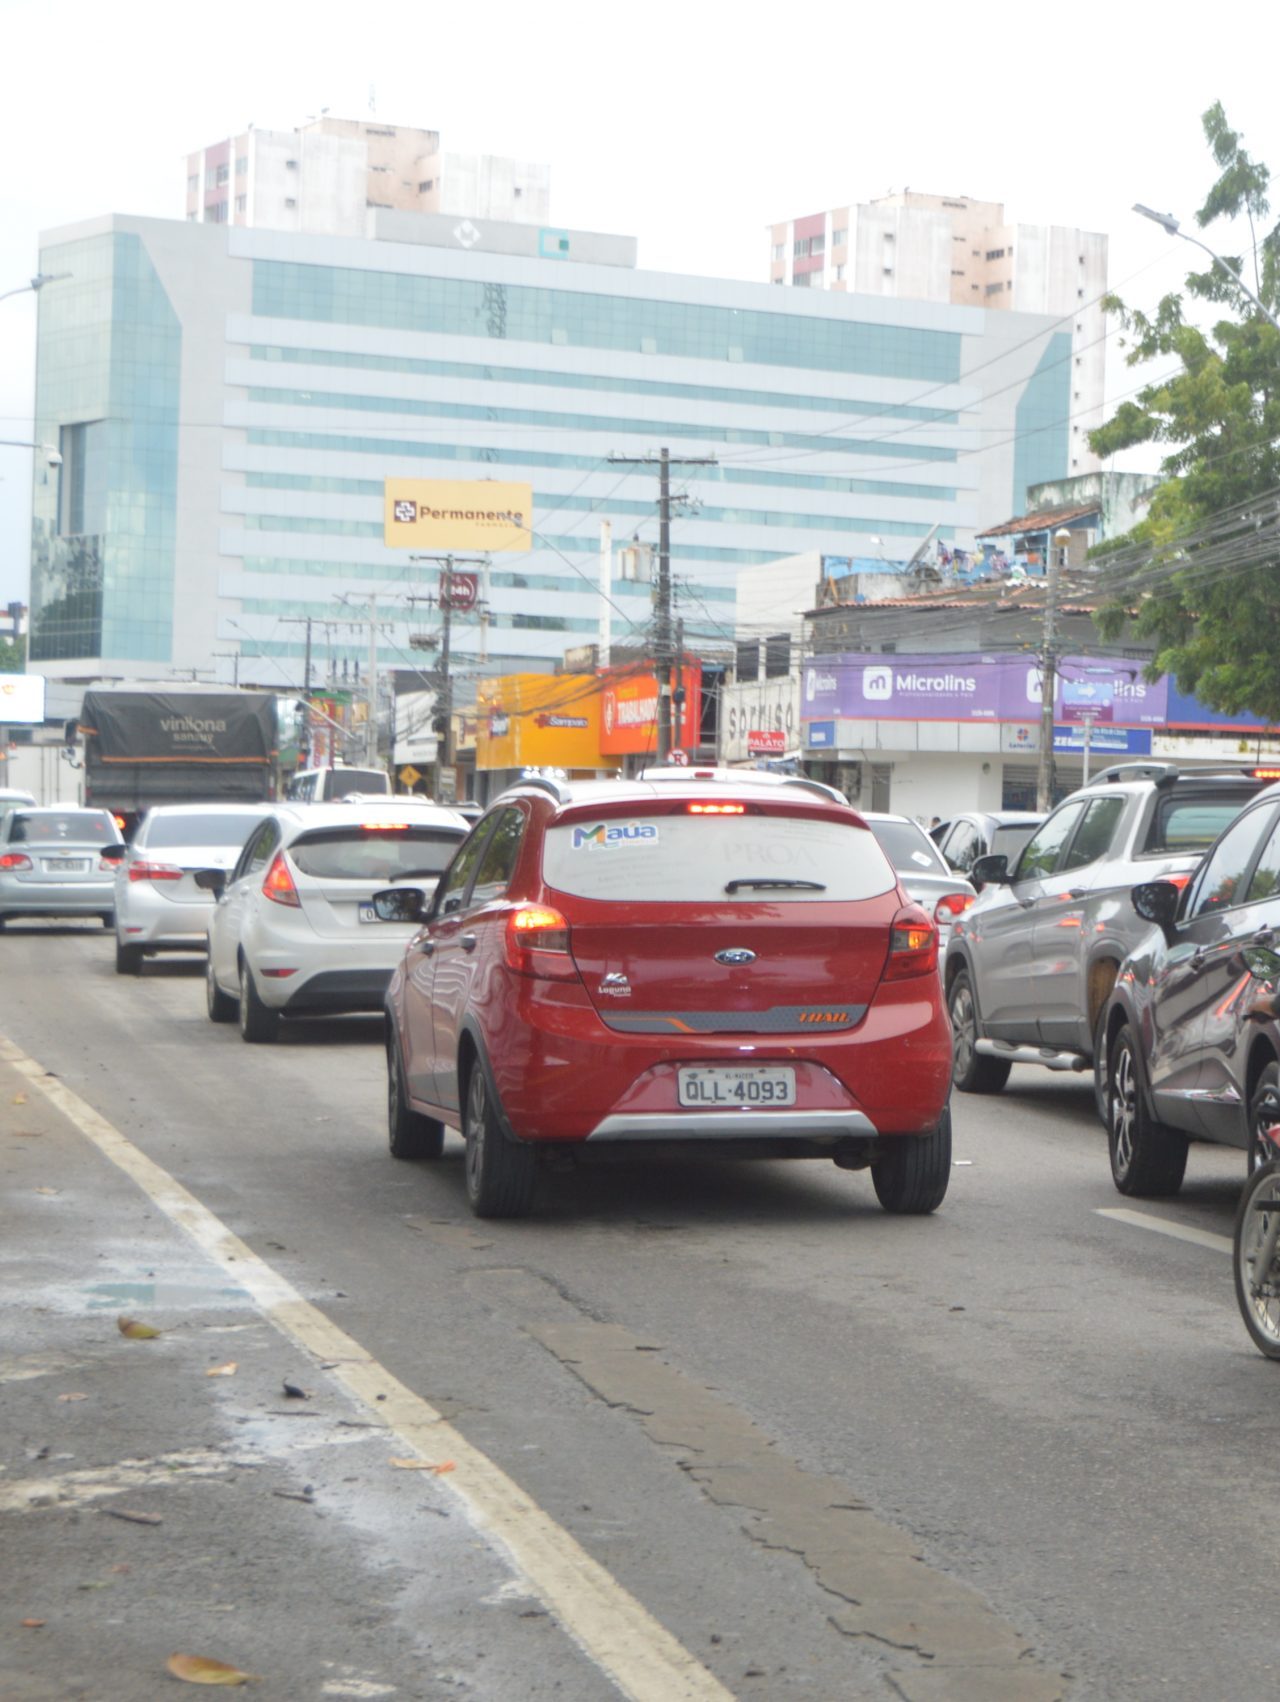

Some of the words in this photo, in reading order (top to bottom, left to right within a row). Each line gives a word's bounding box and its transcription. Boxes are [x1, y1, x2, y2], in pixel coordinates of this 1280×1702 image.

[420, 506, 523, 521] Permanente
[896, 674, 976, 691] Microlins
[799, 1012, 849, 1022] TRAIL
